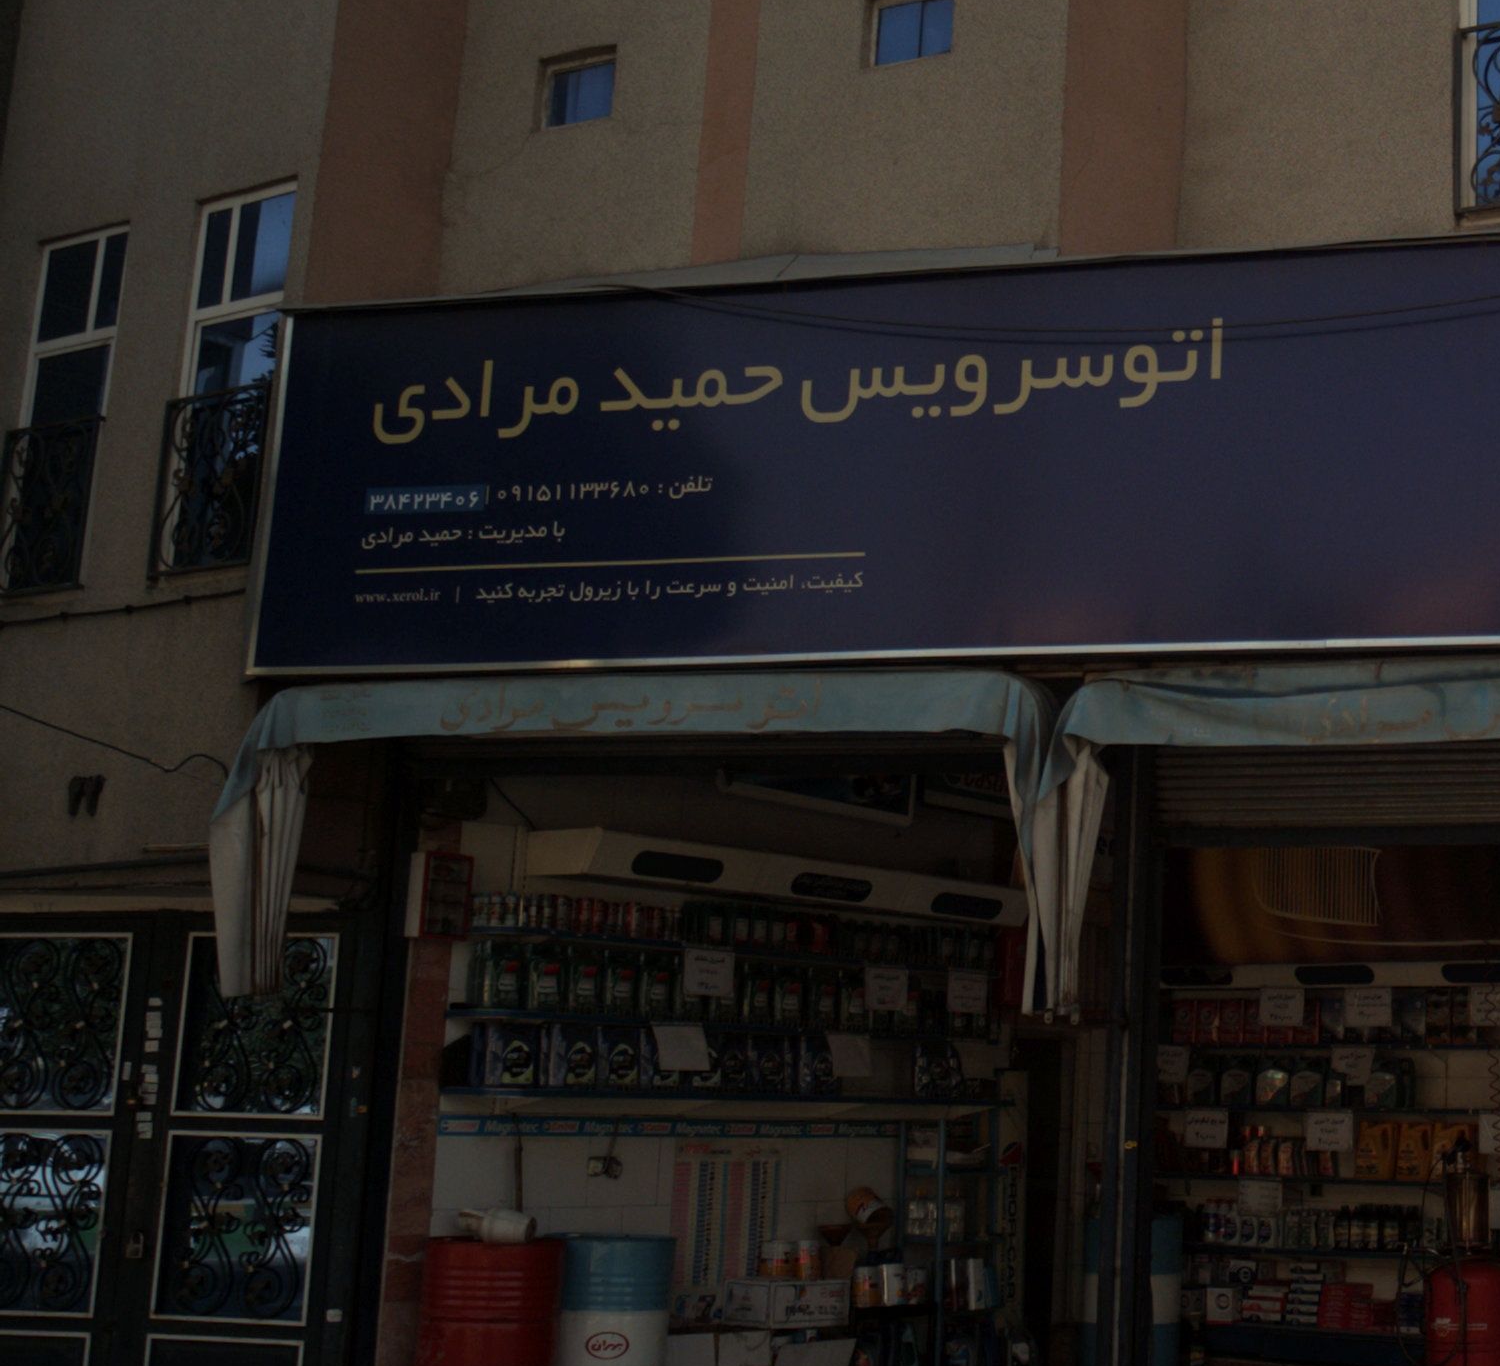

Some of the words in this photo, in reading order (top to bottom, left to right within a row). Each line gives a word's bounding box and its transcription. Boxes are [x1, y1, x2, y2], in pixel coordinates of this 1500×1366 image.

[372, 359, 580, 445] مرادی
[600, 359, 783, 432] حمید
[369, 491, 480, 511] ۳۸۴۲۳۴۰۶
[361, 526, 414, 550] مرادی
[419, 525, 463, 547] حمید
[552, 521, 566, 542] با
[475, 582, 514, 603] کنید
[518, 584, 565, 603] تجربه
[569, 581, 622, 602] زیرول
[626, 580, 640, 597] با
[646, 580, 660, 601] را
[666, 579, 722, 599] سرعت
[726, 581, 737, 597] و
[743, 574, 794, 596] امنیت
